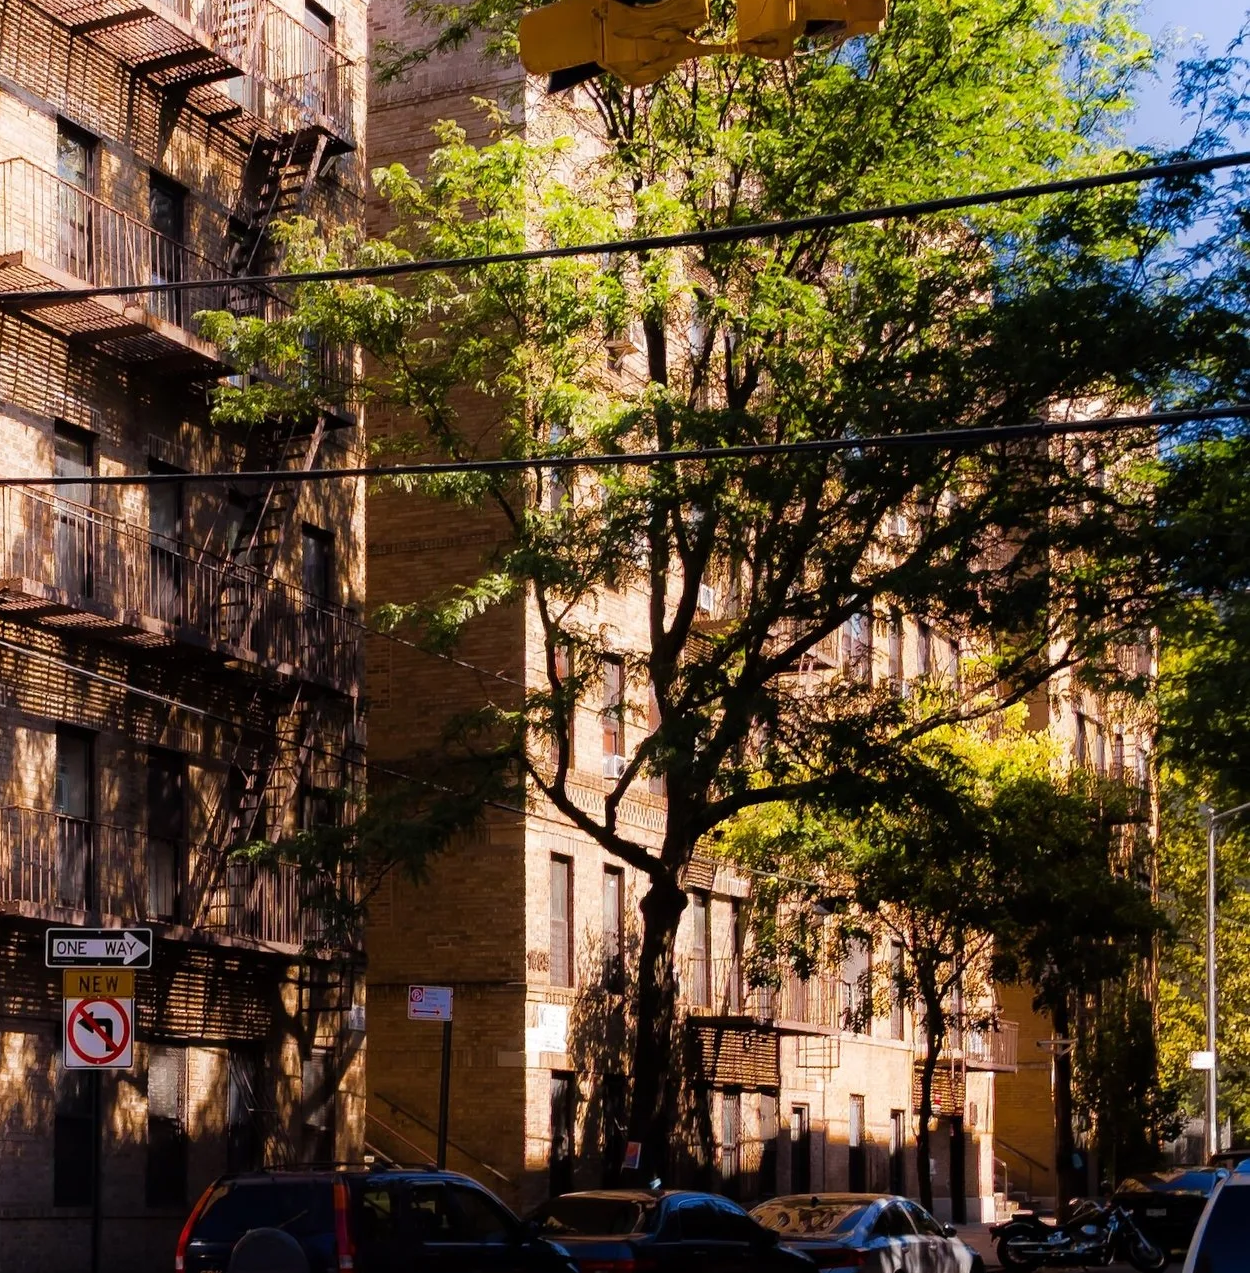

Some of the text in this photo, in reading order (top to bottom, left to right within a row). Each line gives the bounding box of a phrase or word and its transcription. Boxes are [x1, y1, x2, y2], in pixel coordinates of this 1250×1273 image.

[56, 941, 137, 955] ONE WAY
[79, 975, 119, 993] NEW
